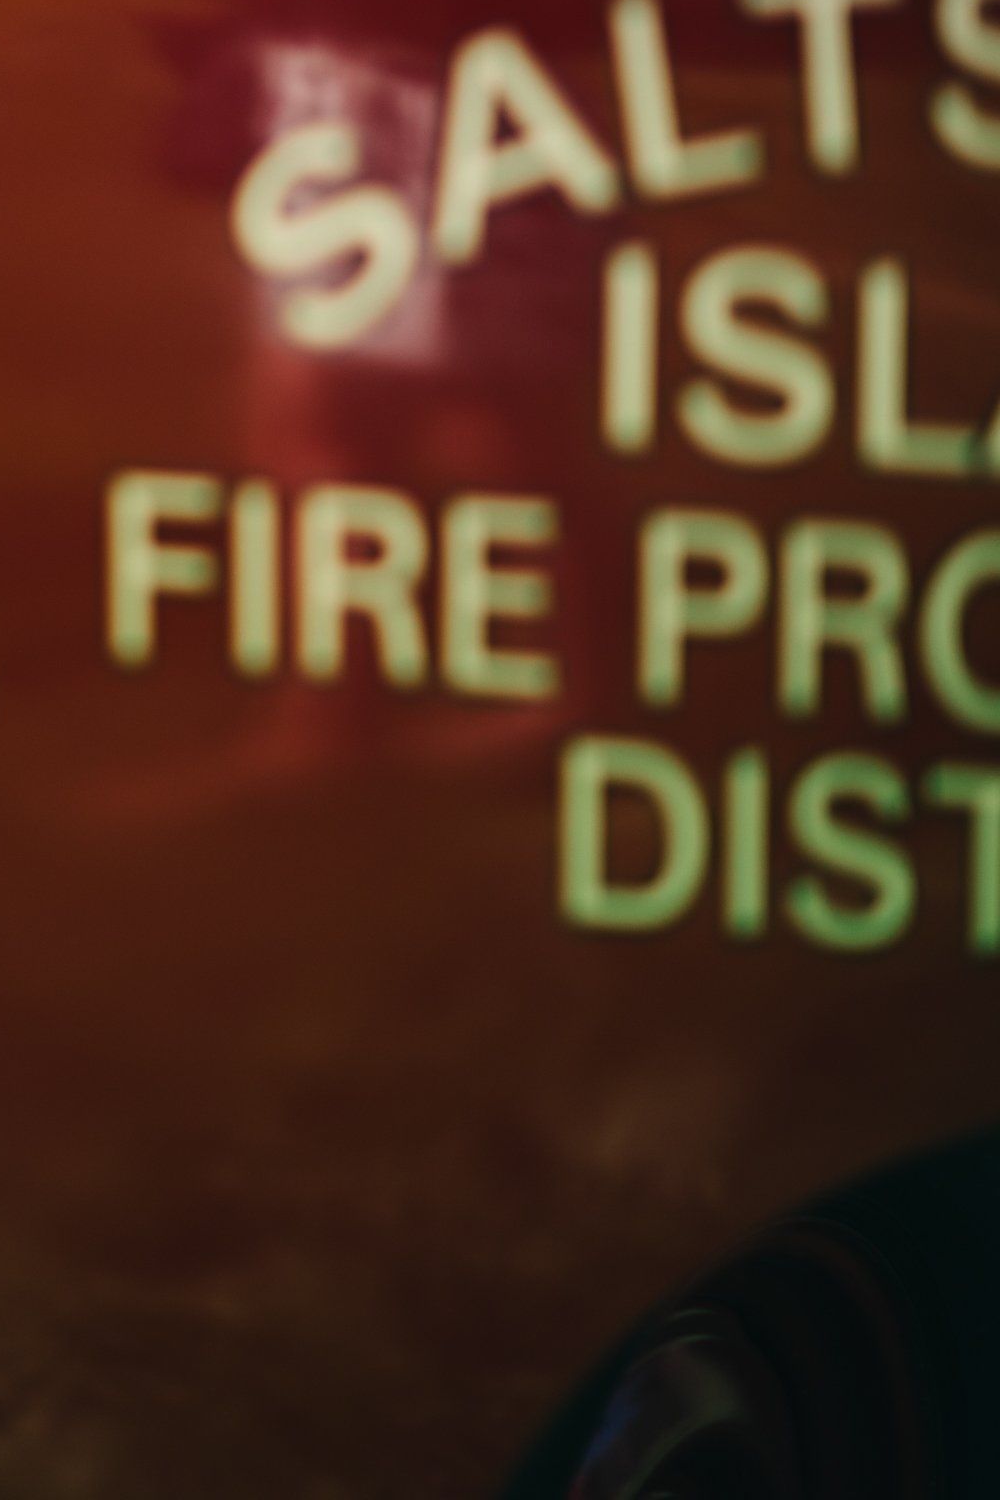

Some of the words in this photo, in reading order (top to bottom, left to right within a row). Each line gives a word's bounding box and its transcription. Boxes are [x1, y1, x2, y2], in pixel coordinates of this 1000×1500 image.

[602, 242, 1000, 474] ISL
[107, 472, 558, 697] FIRE
[559, 734, 1000, 953] DIST
